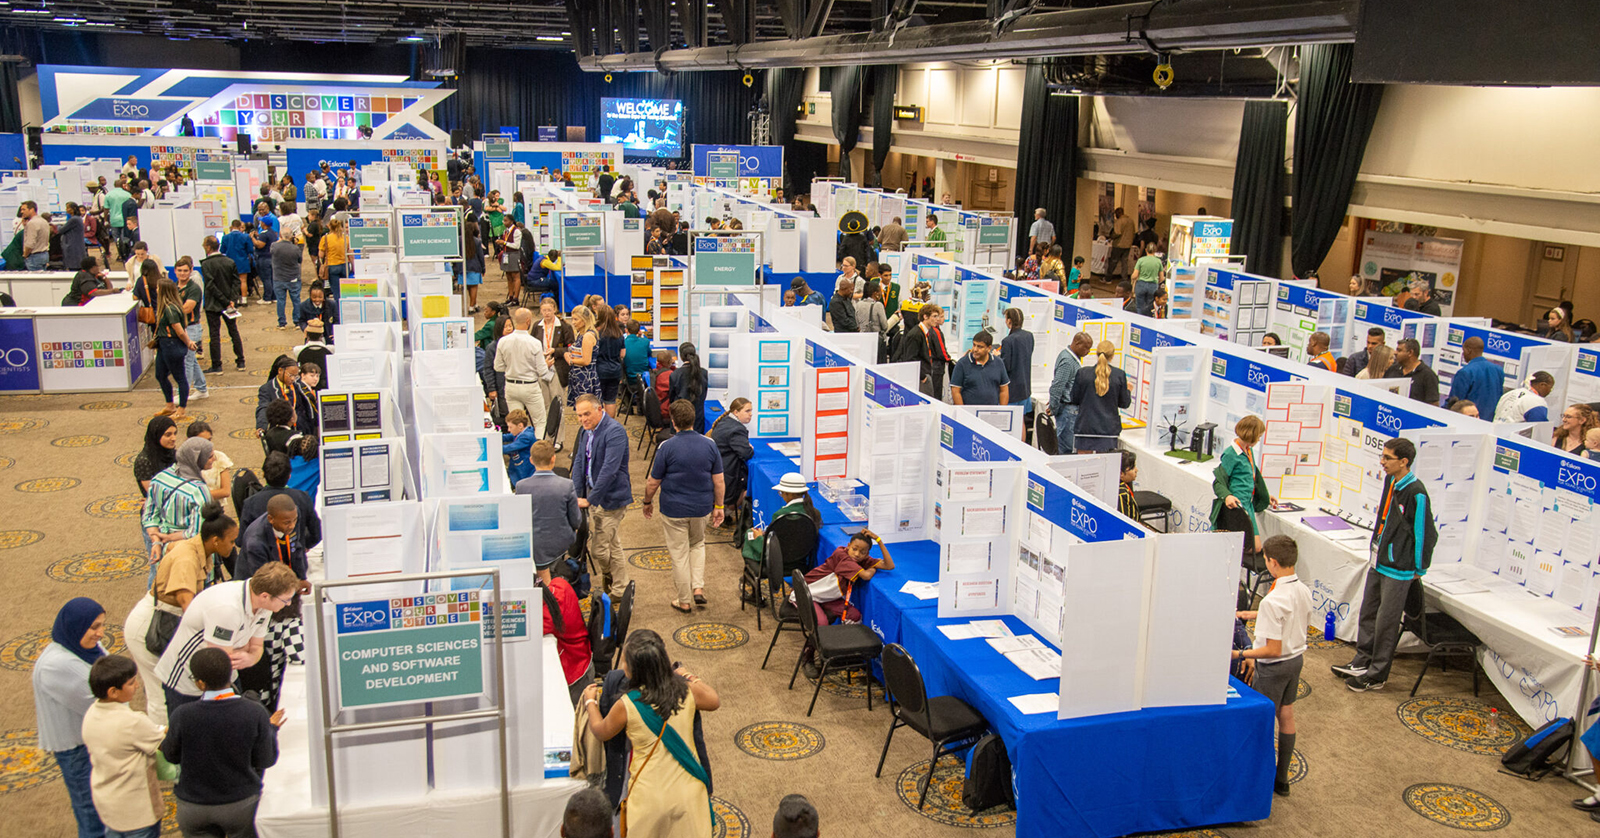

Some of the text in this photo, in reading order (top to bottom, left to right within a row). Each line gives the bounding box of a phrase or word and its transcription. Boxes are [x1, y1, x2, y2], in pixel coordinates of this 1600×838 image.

[239, 96, 367, 109] DISCOVER
[616, 102, 669, 115] WELCOME
[113, 104, 149, 118] EXPO
[240, 111, 302, 125] YOUR
[328, 161, 349, 169] Eskom
[1203, 227, 1223, 236] EXPO
[1304, 295, 1321, 305] EXPO
[1384, 312, 1402, 324] EXPO
[43, 341, 121, 350] DISCOVER
[1155, 339, 1171, 347] EXPO
[1487, 337, 1511, 351] EXPO
[45, 350, 83, 359] YOUR
[46, 359, 103, 368] FUTURE
[1248, 370, 1270, 384] EXPO
[889, 390, 905, 408] EXPO
[1376, 411, 1402, 430] EXPO
[971, 442, 990, 462] EXPO
[1566, 461, 1581, 470] Eskom
[1558, 467, 1597, 490] EXPO
[1071, 507, 1097, 533] EXPO
[1189, 515, 1213, 532] EXP
[393, 592, 478, 607] DISCOVER
[1312, 590, 1350, 620] EXPO
[343, 610, 385, 625] EXPO
[394, 605, 434, 616] YOUR
[394, 614, 456, 627] FUTURE
[342, 638, 478, 661] COMPUTER SCIENCES
[361, 655, 461, 675] AND SOFTWARE
[366, 671, 459, 690] DEVELOPMENT
[1519, 677, 1558, 723] EXPO
